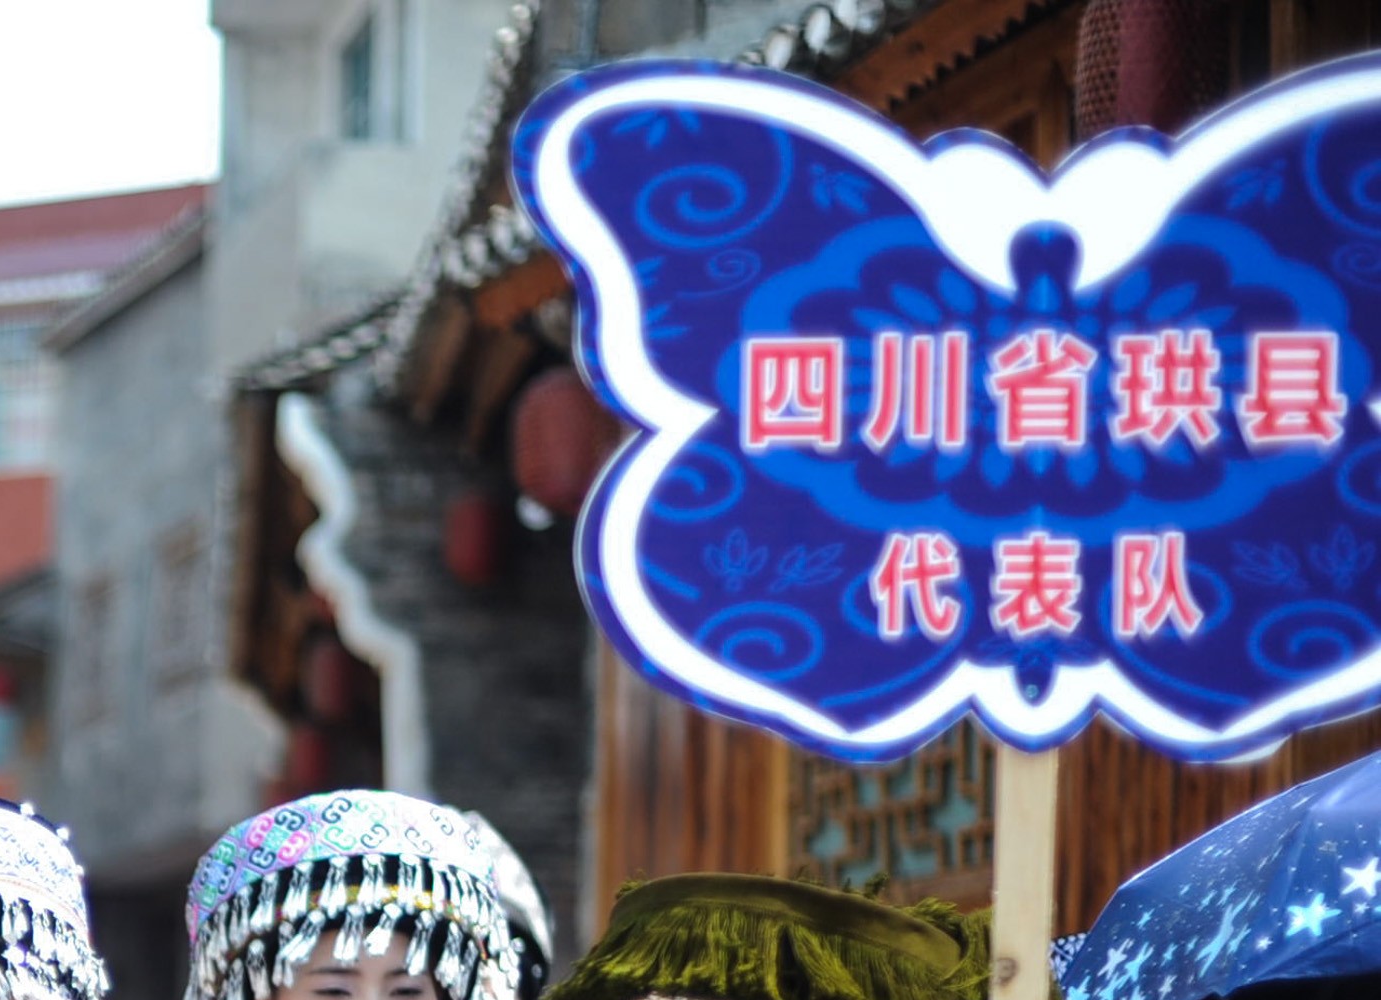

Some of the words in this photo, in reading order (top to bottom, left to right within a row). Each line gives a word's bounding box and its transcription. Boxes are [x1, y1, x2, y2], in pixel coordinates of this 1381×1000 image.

[744, 330, 1345, 447] 四川省珙县
[870, 533, 1203, 638] 代表队
